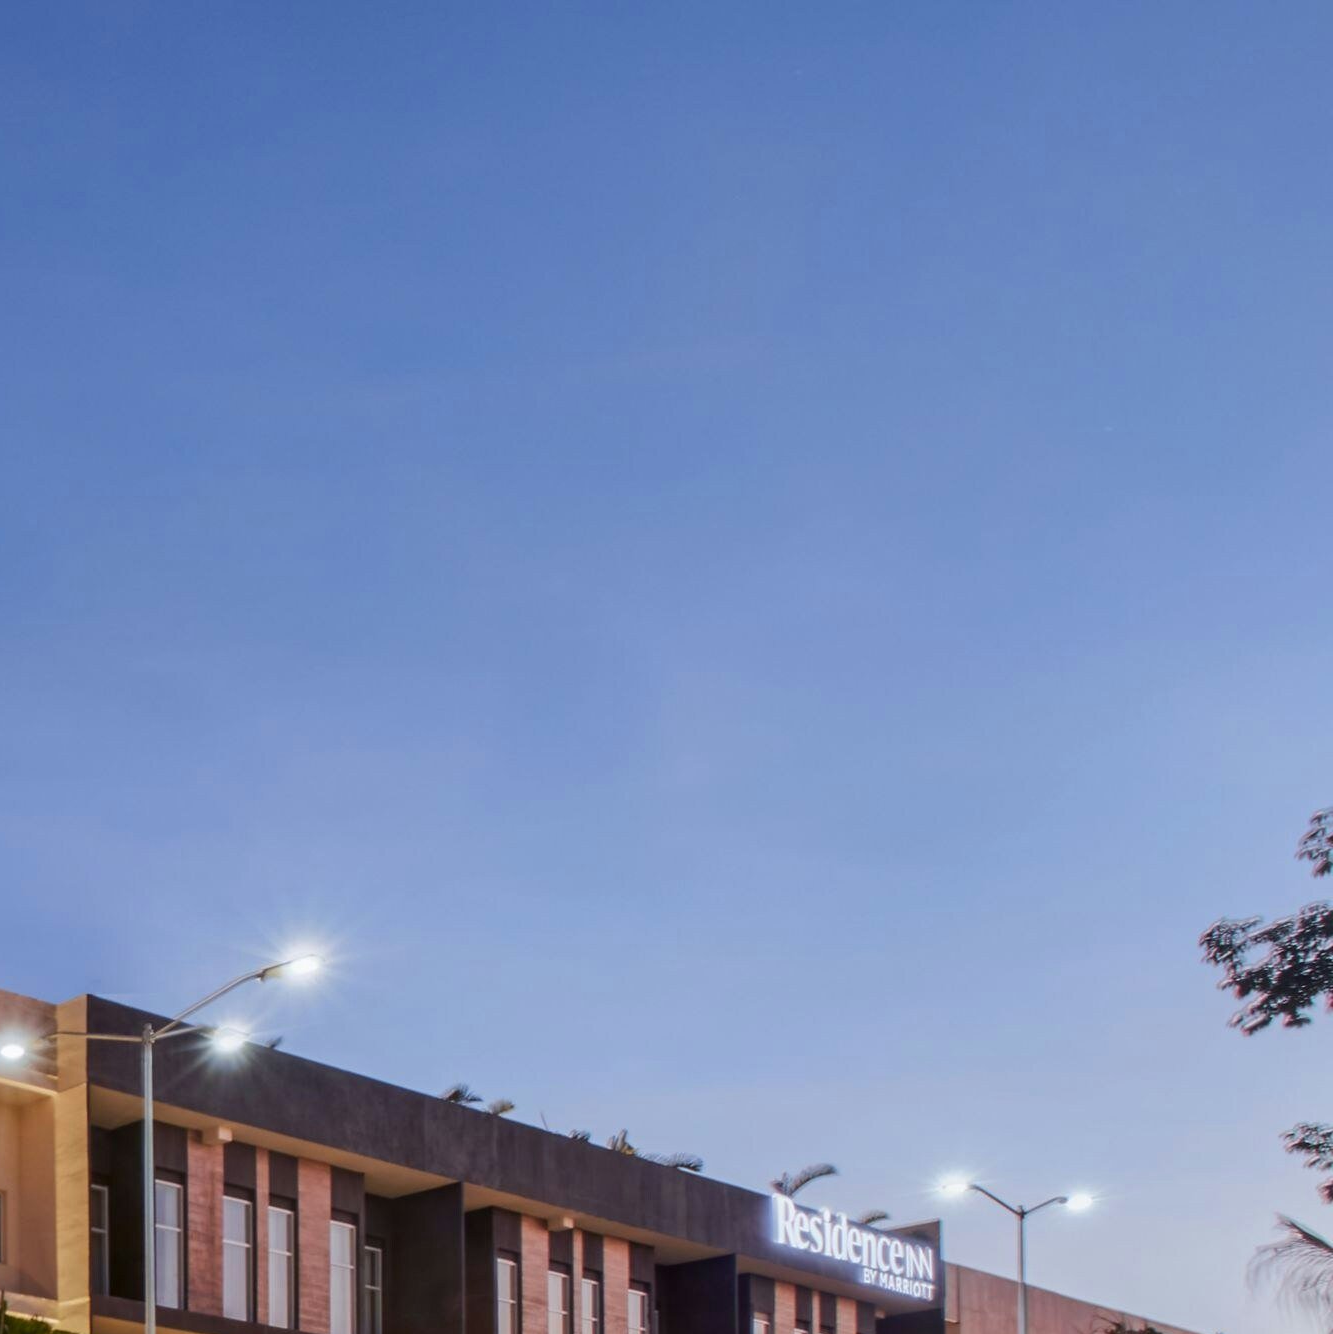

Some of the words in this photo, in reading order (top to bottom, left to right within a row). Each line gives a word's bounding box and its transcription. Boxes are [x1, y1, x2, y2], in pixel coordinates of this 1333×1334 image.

[774, 1194, 904, 1272] Residence
[906, 1244, 933, 1279] INN
[864, 1268, 877, 1284] BY
[880, 1272, 933, 1301] MARRIOTT
